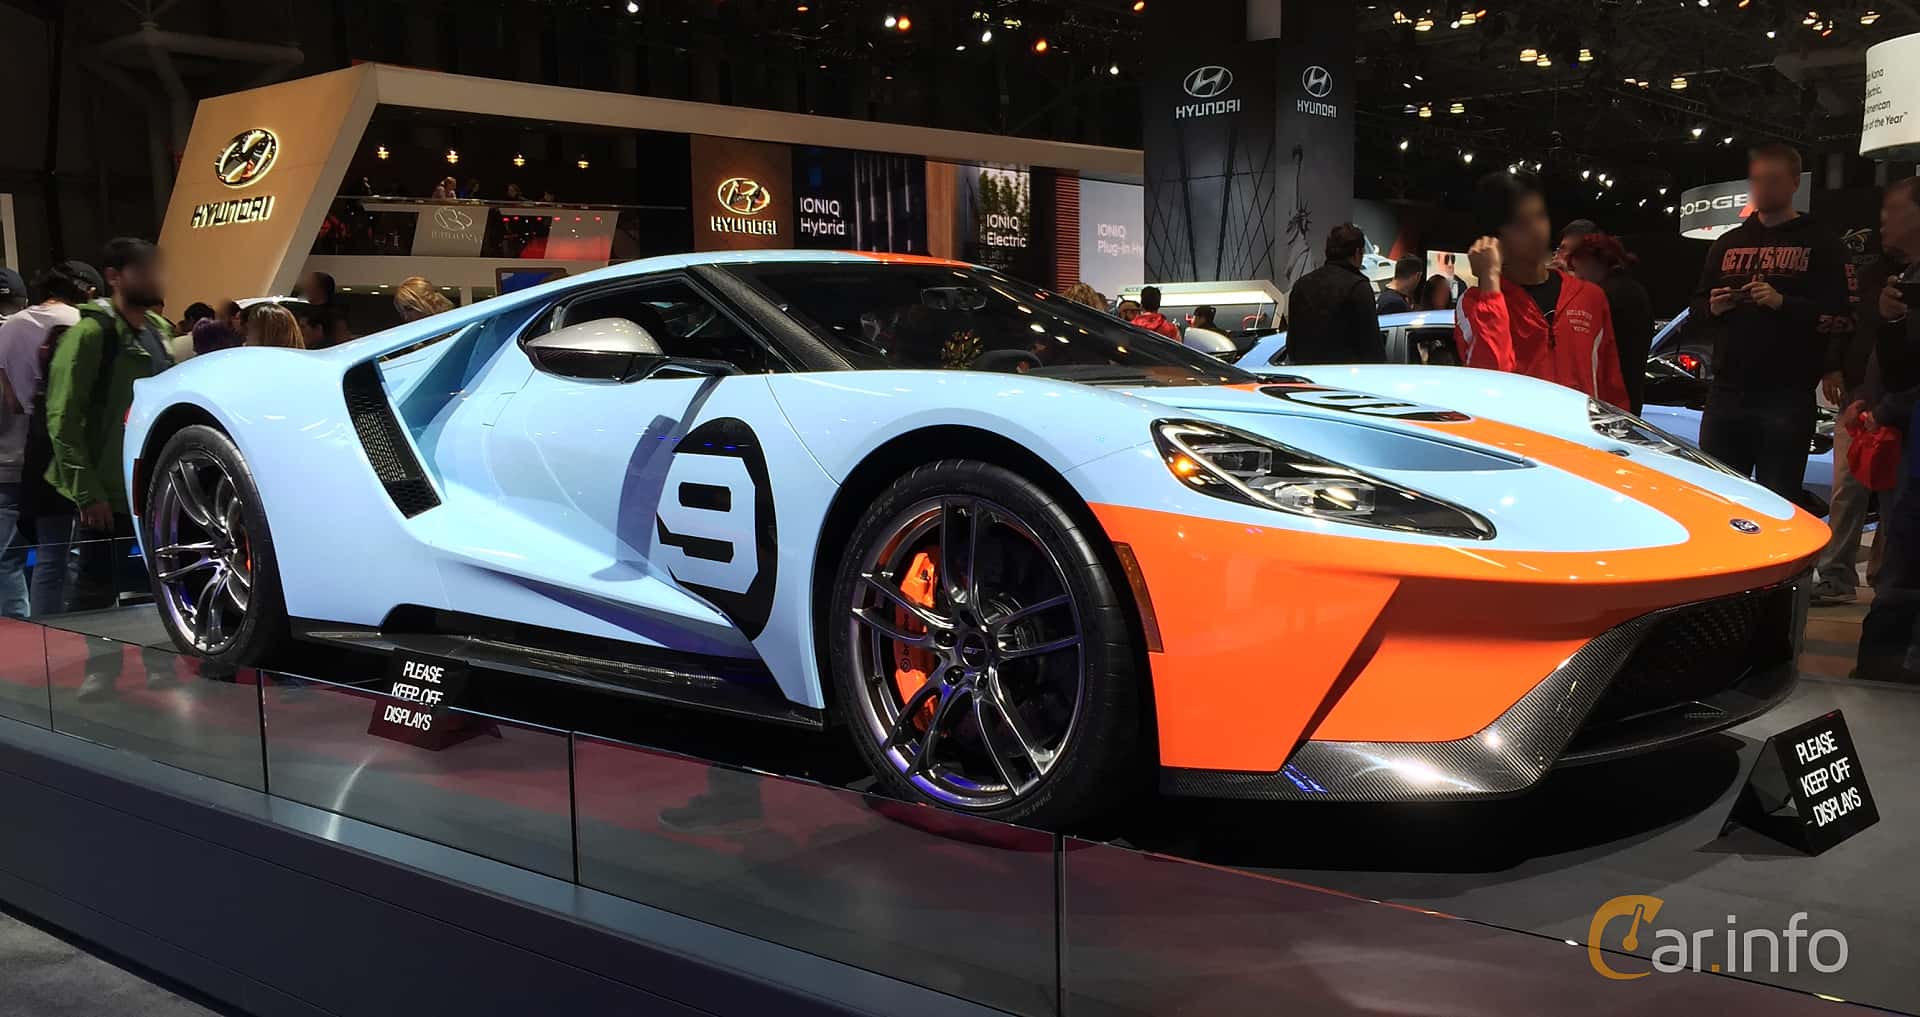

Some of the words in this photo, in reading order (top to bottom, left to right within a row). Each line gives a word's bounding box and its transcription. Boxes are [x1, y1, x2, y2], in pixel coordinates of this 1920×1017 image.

[1175, 99, 1241, 119] HYUNDAI
[1296, 99, 1337, 118] HYUNDAI
[190, 195, 275, 228] HYUNDAI
[800, 197, 840, 217] IONIQ
[710, 216, 777, 236] HYUNDAI
[800, 218, 846, 237] Hybrid
[986, 213, 1020, 231] IONIQ
[1097, 223, 1127, 240] IONIQ
[986, 231, 1027, 248] Electric
[1132, 243, 1144, 256] Hy
[403, 661, 444, 683] PLEASE
[392, 681, 420, 700] KEEP
[420, 688, 445, 706] OFF
[384, 705, 432, 731] DISPLAYS
[1795, 730, 1838, 765] PLEASE
[1800, 768, 1829, 797] KEEP
[1829, 757, 1850, 783] OFF
[1812, 786, 1861, 827] DISPLAYS
